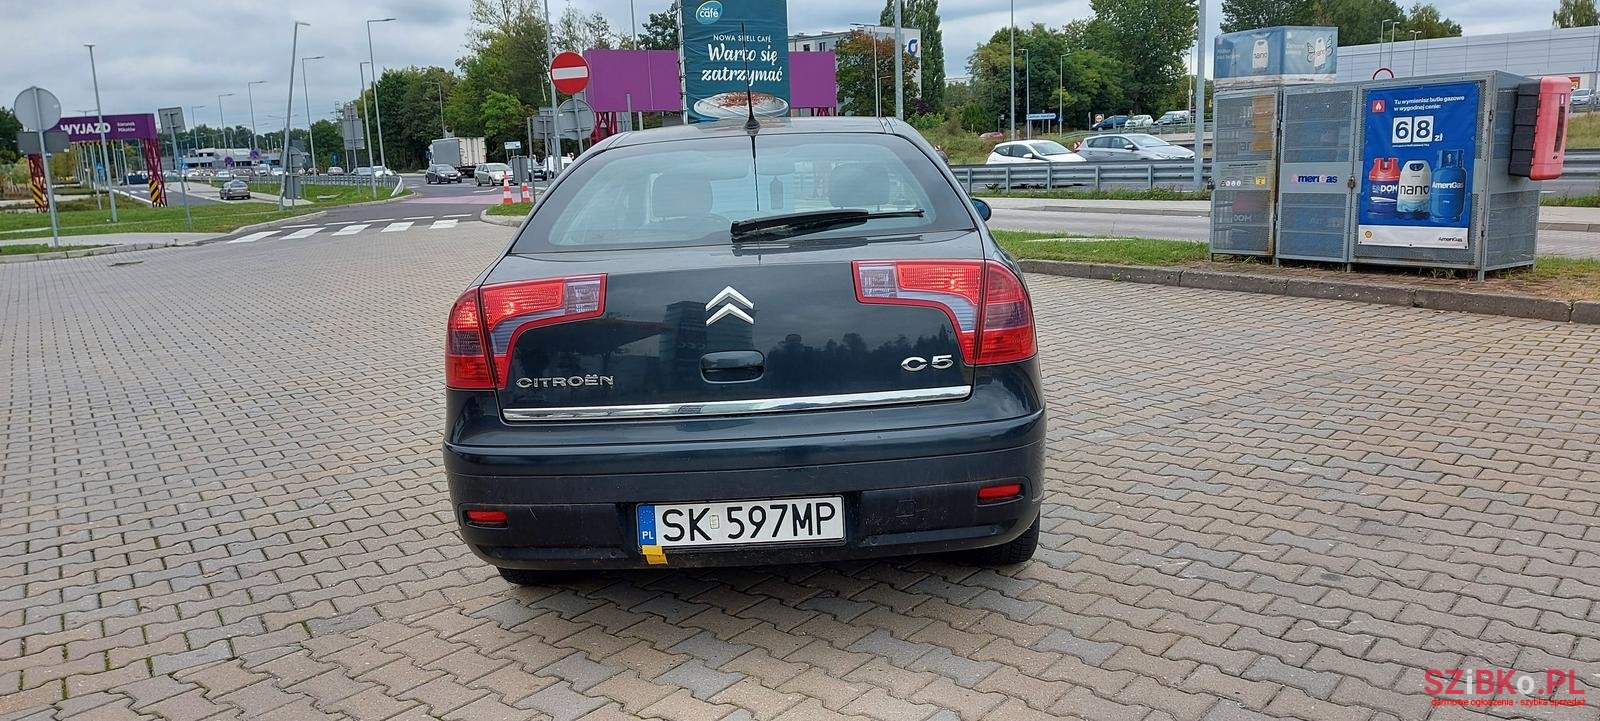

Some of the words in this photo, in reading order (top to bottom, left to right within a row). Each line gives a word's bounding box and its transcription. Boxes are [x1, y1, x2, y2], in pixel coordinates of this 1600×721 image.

[699, 8, 718, 18] café
[738, 35, 756, 43] SHELL
[708, 43, 756, 61] Warto
[761, 45, 778, 66] się
[702, 66, 782, 86] zatrzymać
[1402, 97, 1430, 106] wymienisz
[60, 122, 111, 135] WYJAZD
[1395, 120, 1431, 140] 68
[1434, 132, 1443, 142] zł
[1400, 185, 1429, 195] nano
[516, 374, 614, 388] CITROËN
[661, 507, 713, 542] SK
[726, 502, 836, 540] 597MP
[642, 531, 655, 540] PL
